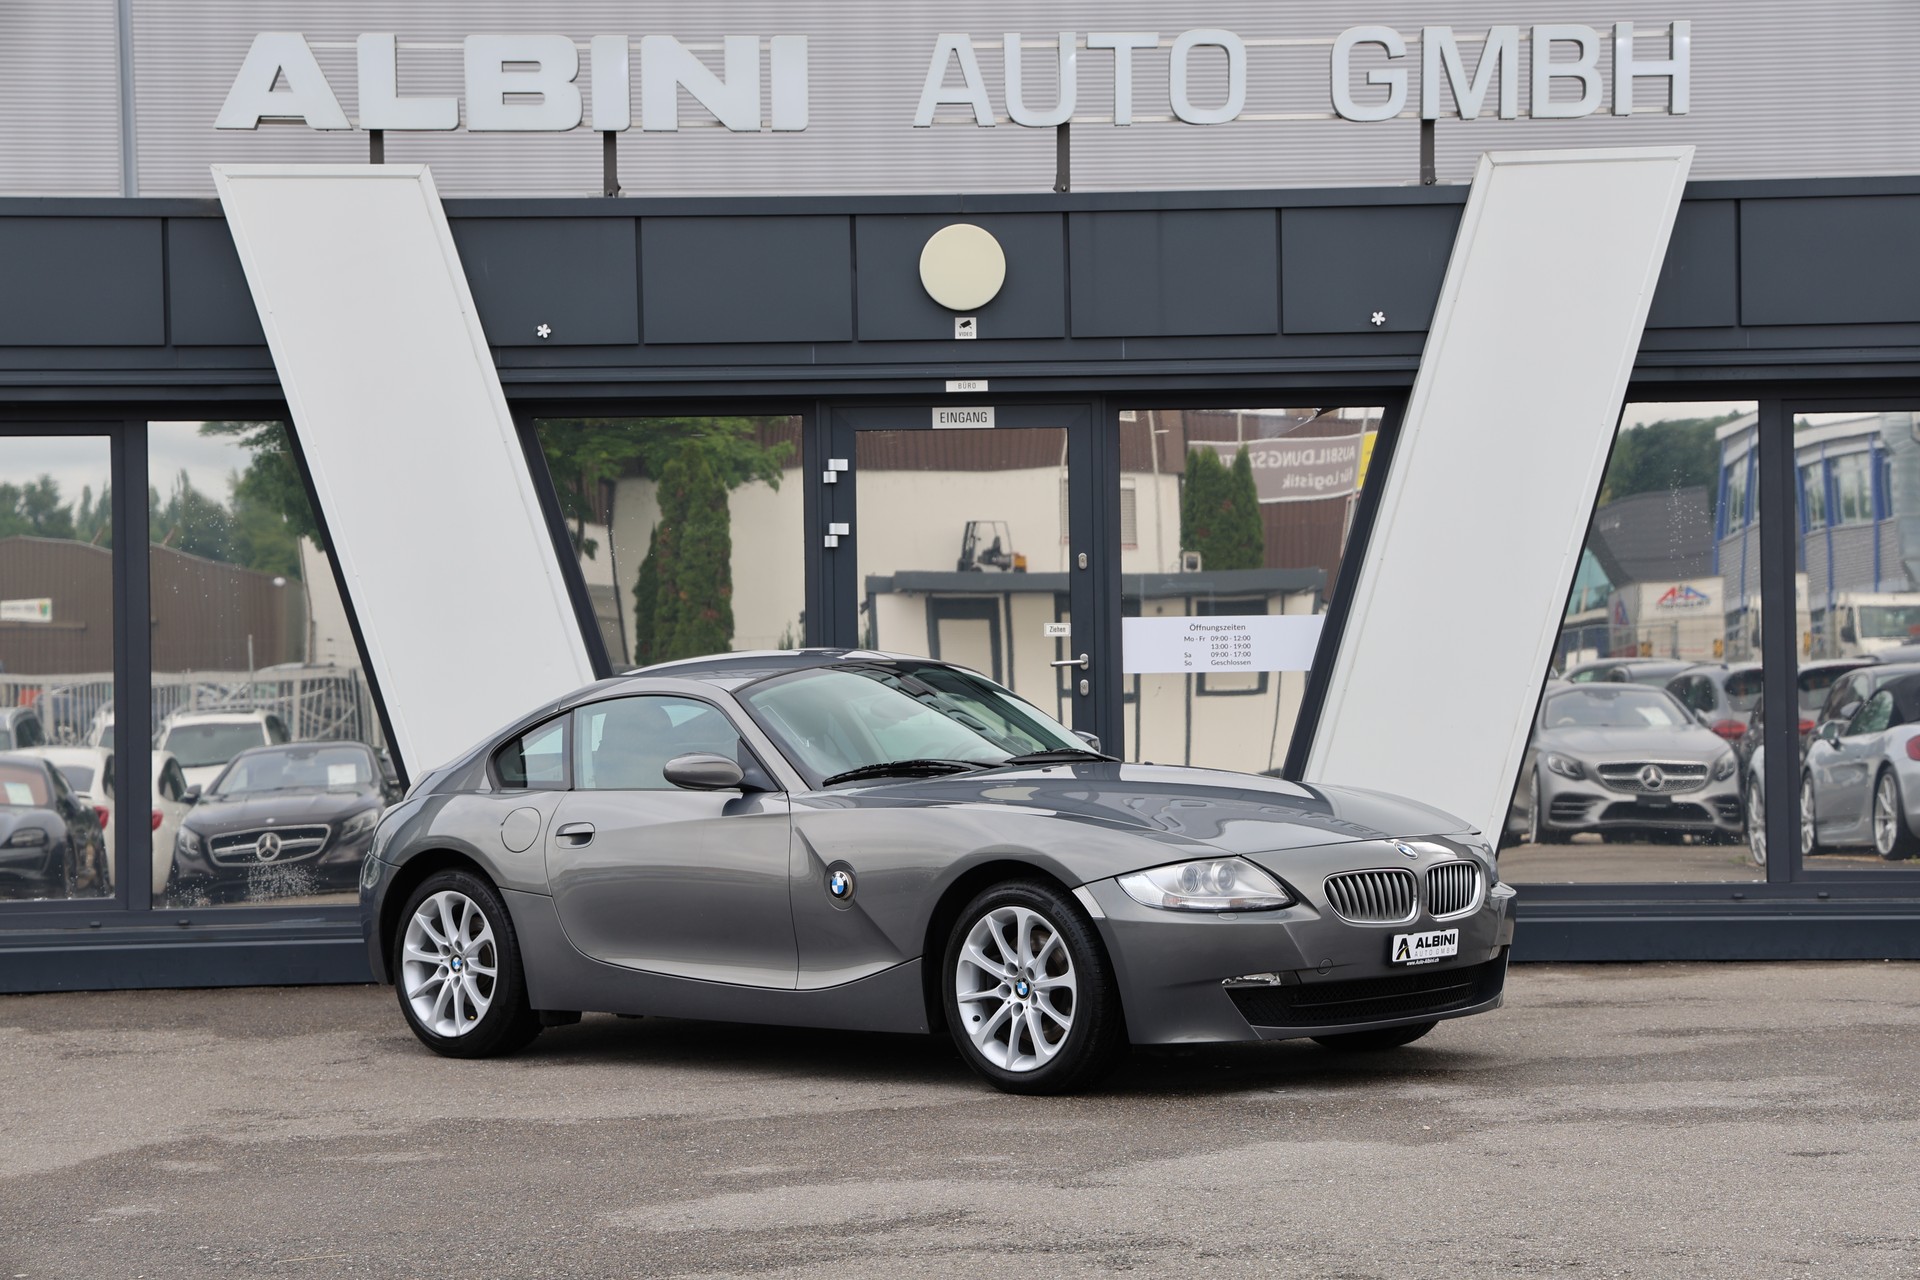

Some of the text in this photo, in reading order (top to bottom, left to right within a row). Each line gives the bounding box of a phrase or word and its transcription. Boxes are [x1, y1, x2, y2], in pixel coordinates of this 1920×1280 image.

[213, 19, 1691, 132] ALBINI AUTO GMBH
[957, 381, 977, 390] BÜRO
[940, 412, 988, 423] EINGANG
[1189, 623, 1246, 632] Öffnungszeiten
[1415, 934, 1456, 949] ALBINI
[1415, 947, 1455, 957] AUTO GMBH
